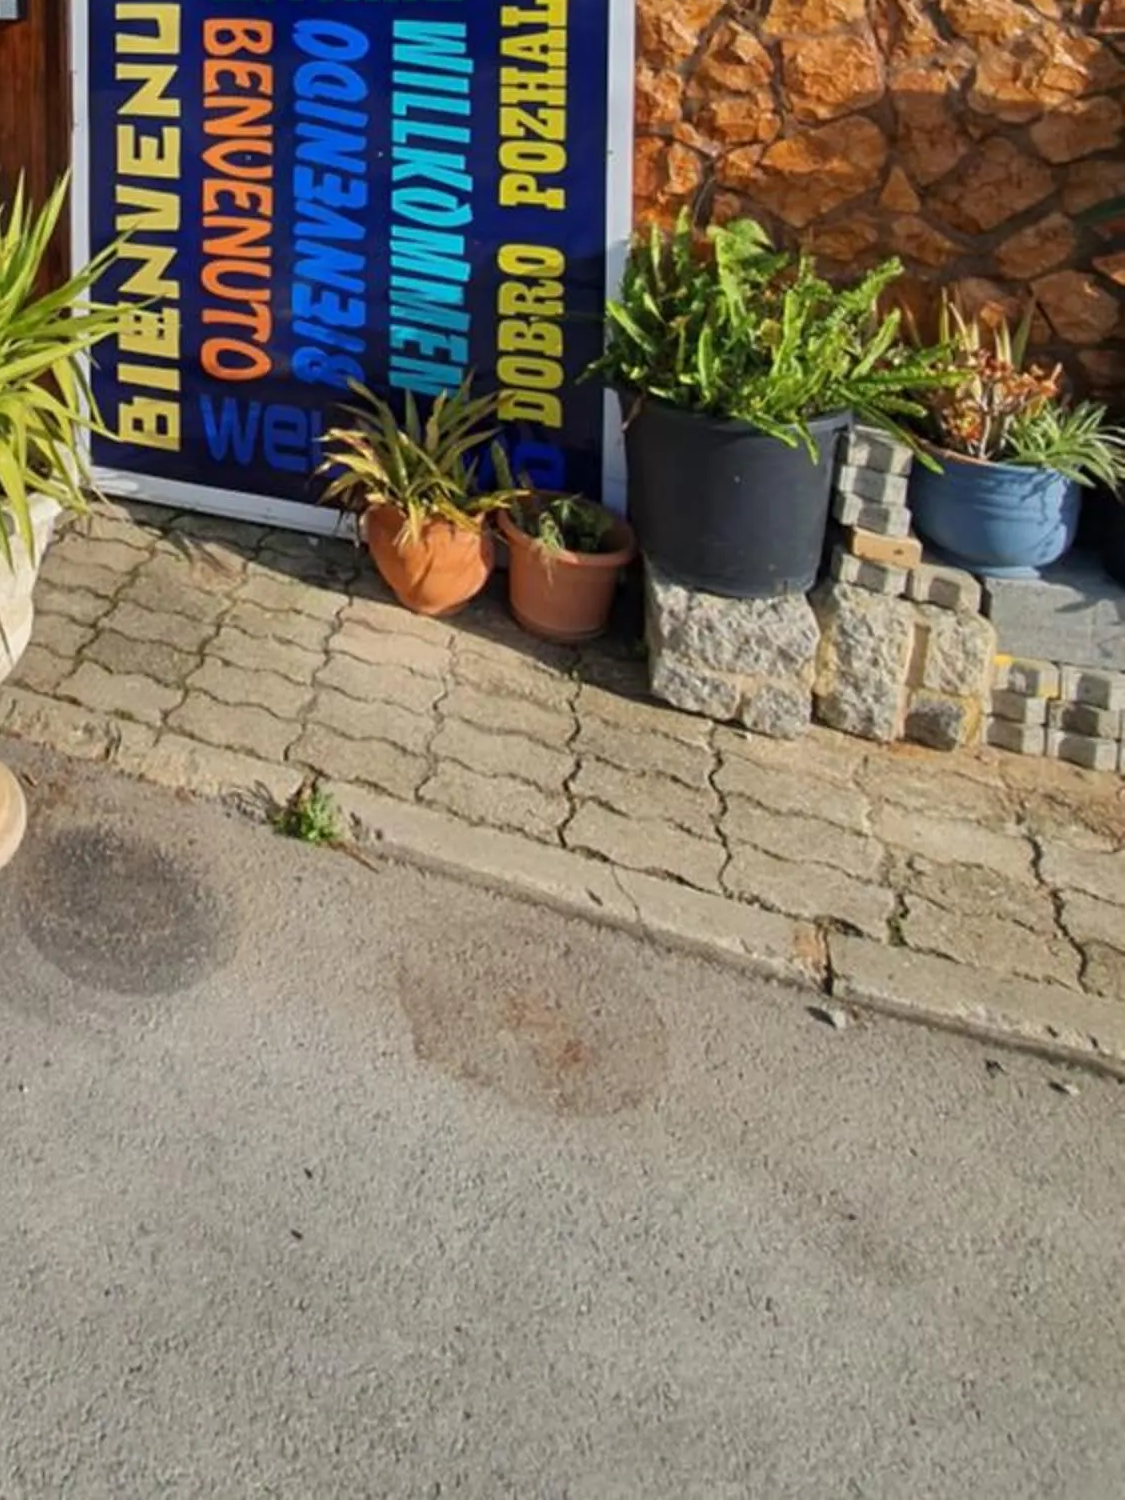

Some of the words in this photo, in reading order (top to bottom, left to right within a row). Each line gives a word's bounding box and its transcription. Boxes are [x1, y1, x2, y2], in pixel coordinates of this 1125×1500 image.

[200, 17, 274, 382] BENVENUTO
[291, 19, 370, 389] BIENVENIDO
[388, 19, 474, 398] WILLKOMMEN
[497, 243, 566, 428] DOBRO
